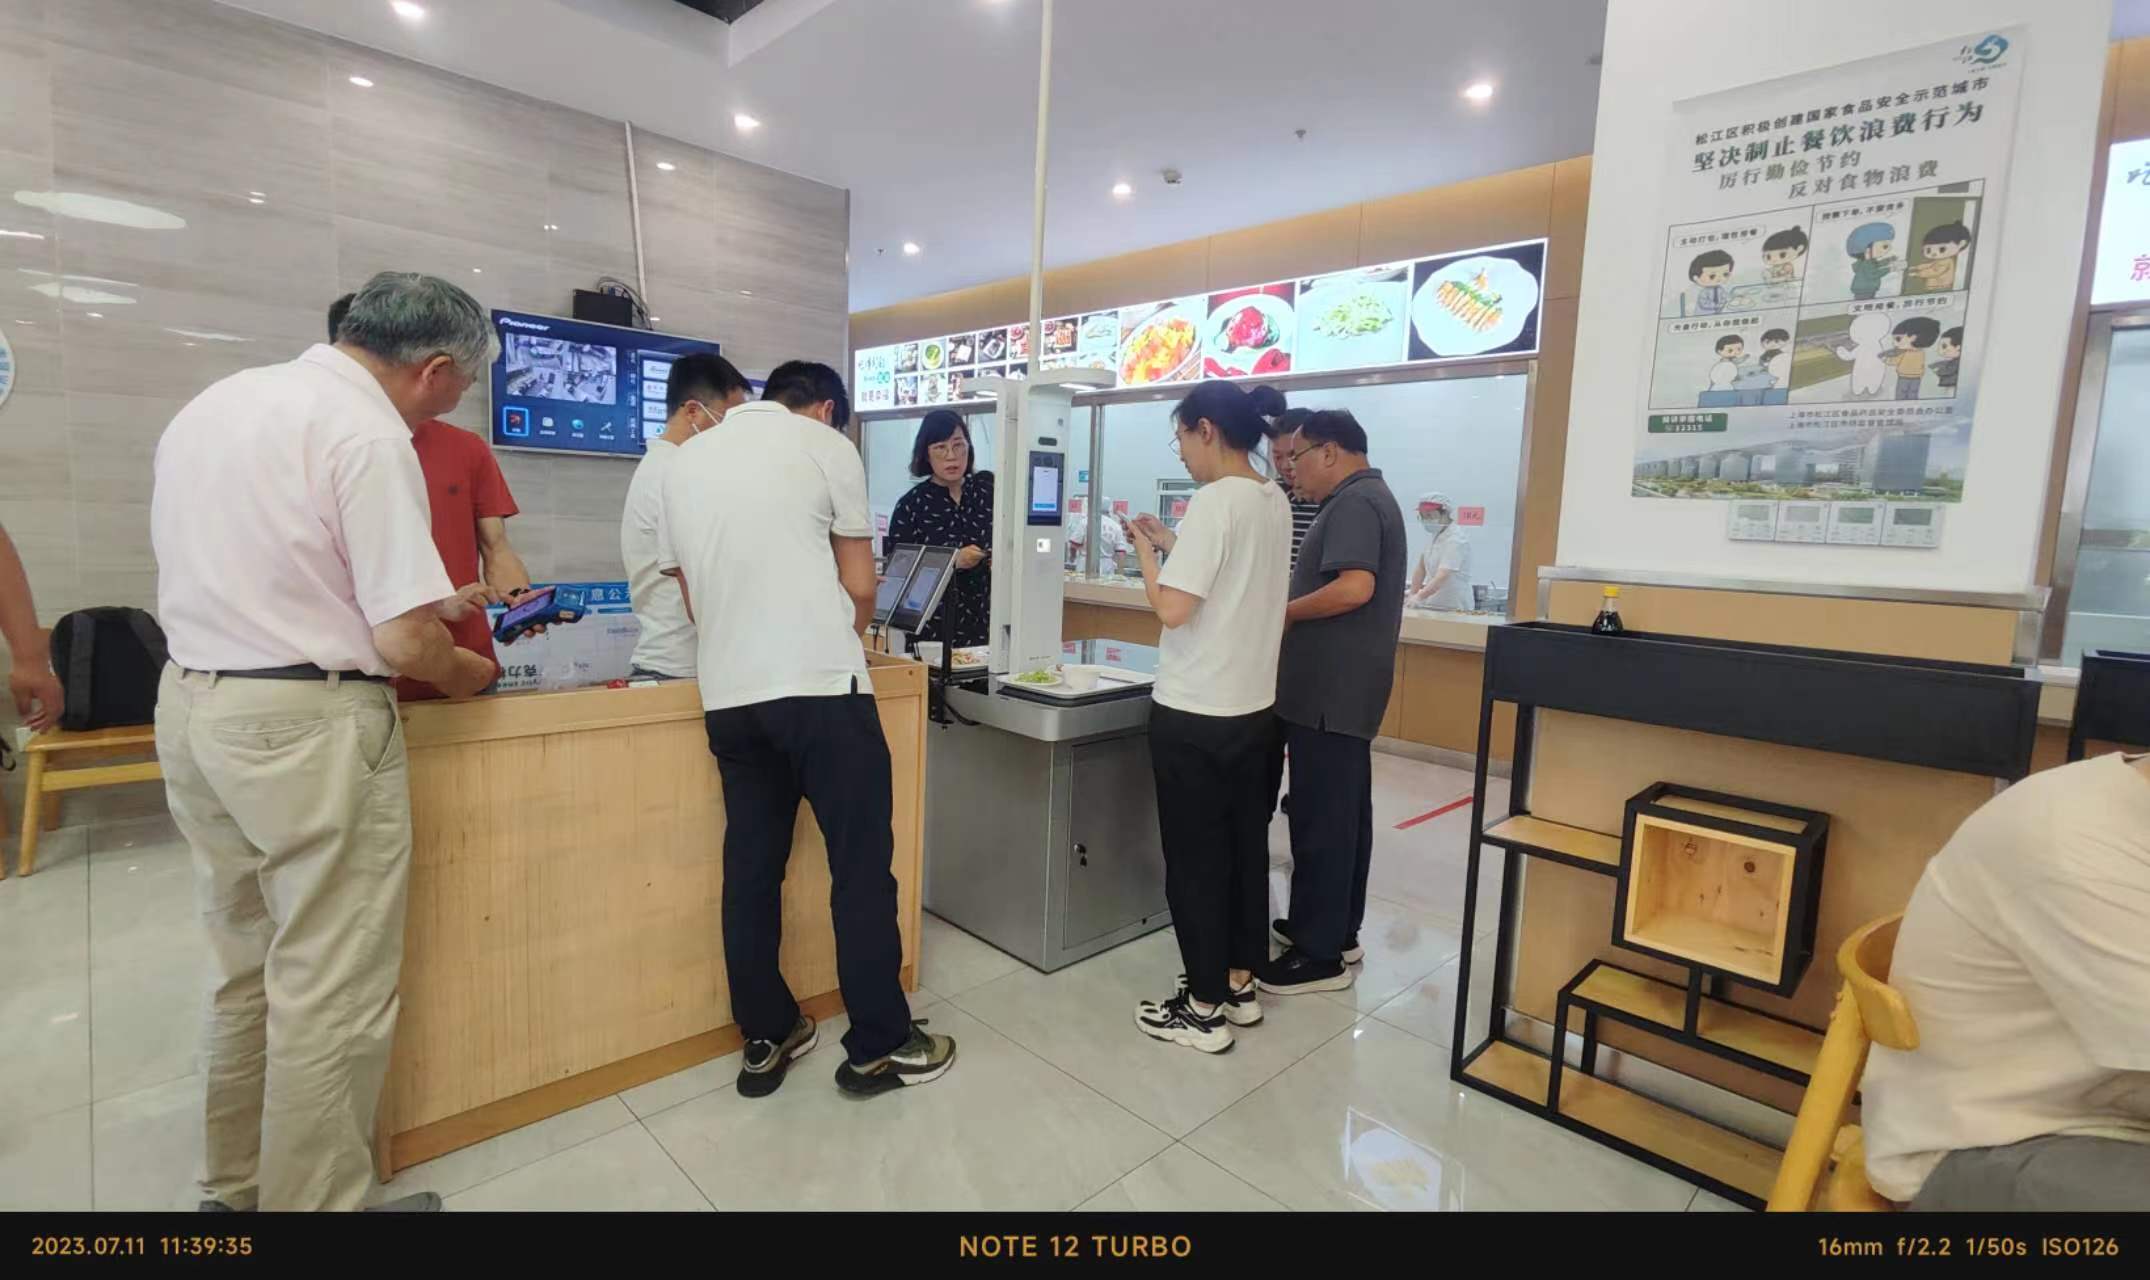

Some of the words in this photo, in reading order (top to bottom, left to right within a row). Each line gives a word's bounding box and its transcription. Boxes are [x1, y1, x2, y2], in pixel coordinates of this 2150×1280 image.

[1695, 77, 1990, 146] 松江区积极创建国家食品安全示范城市
[1692, 100, 1985, 172] 坚决制止餐饮浪费行为
[1718, 150, 1861, 190] 厉行勤俭节约
[1788, 160, 1939, 200] 反对食物浪费
[498, 316, 550, 332] Pioneer
[591, 587, 633, 601] 息公
